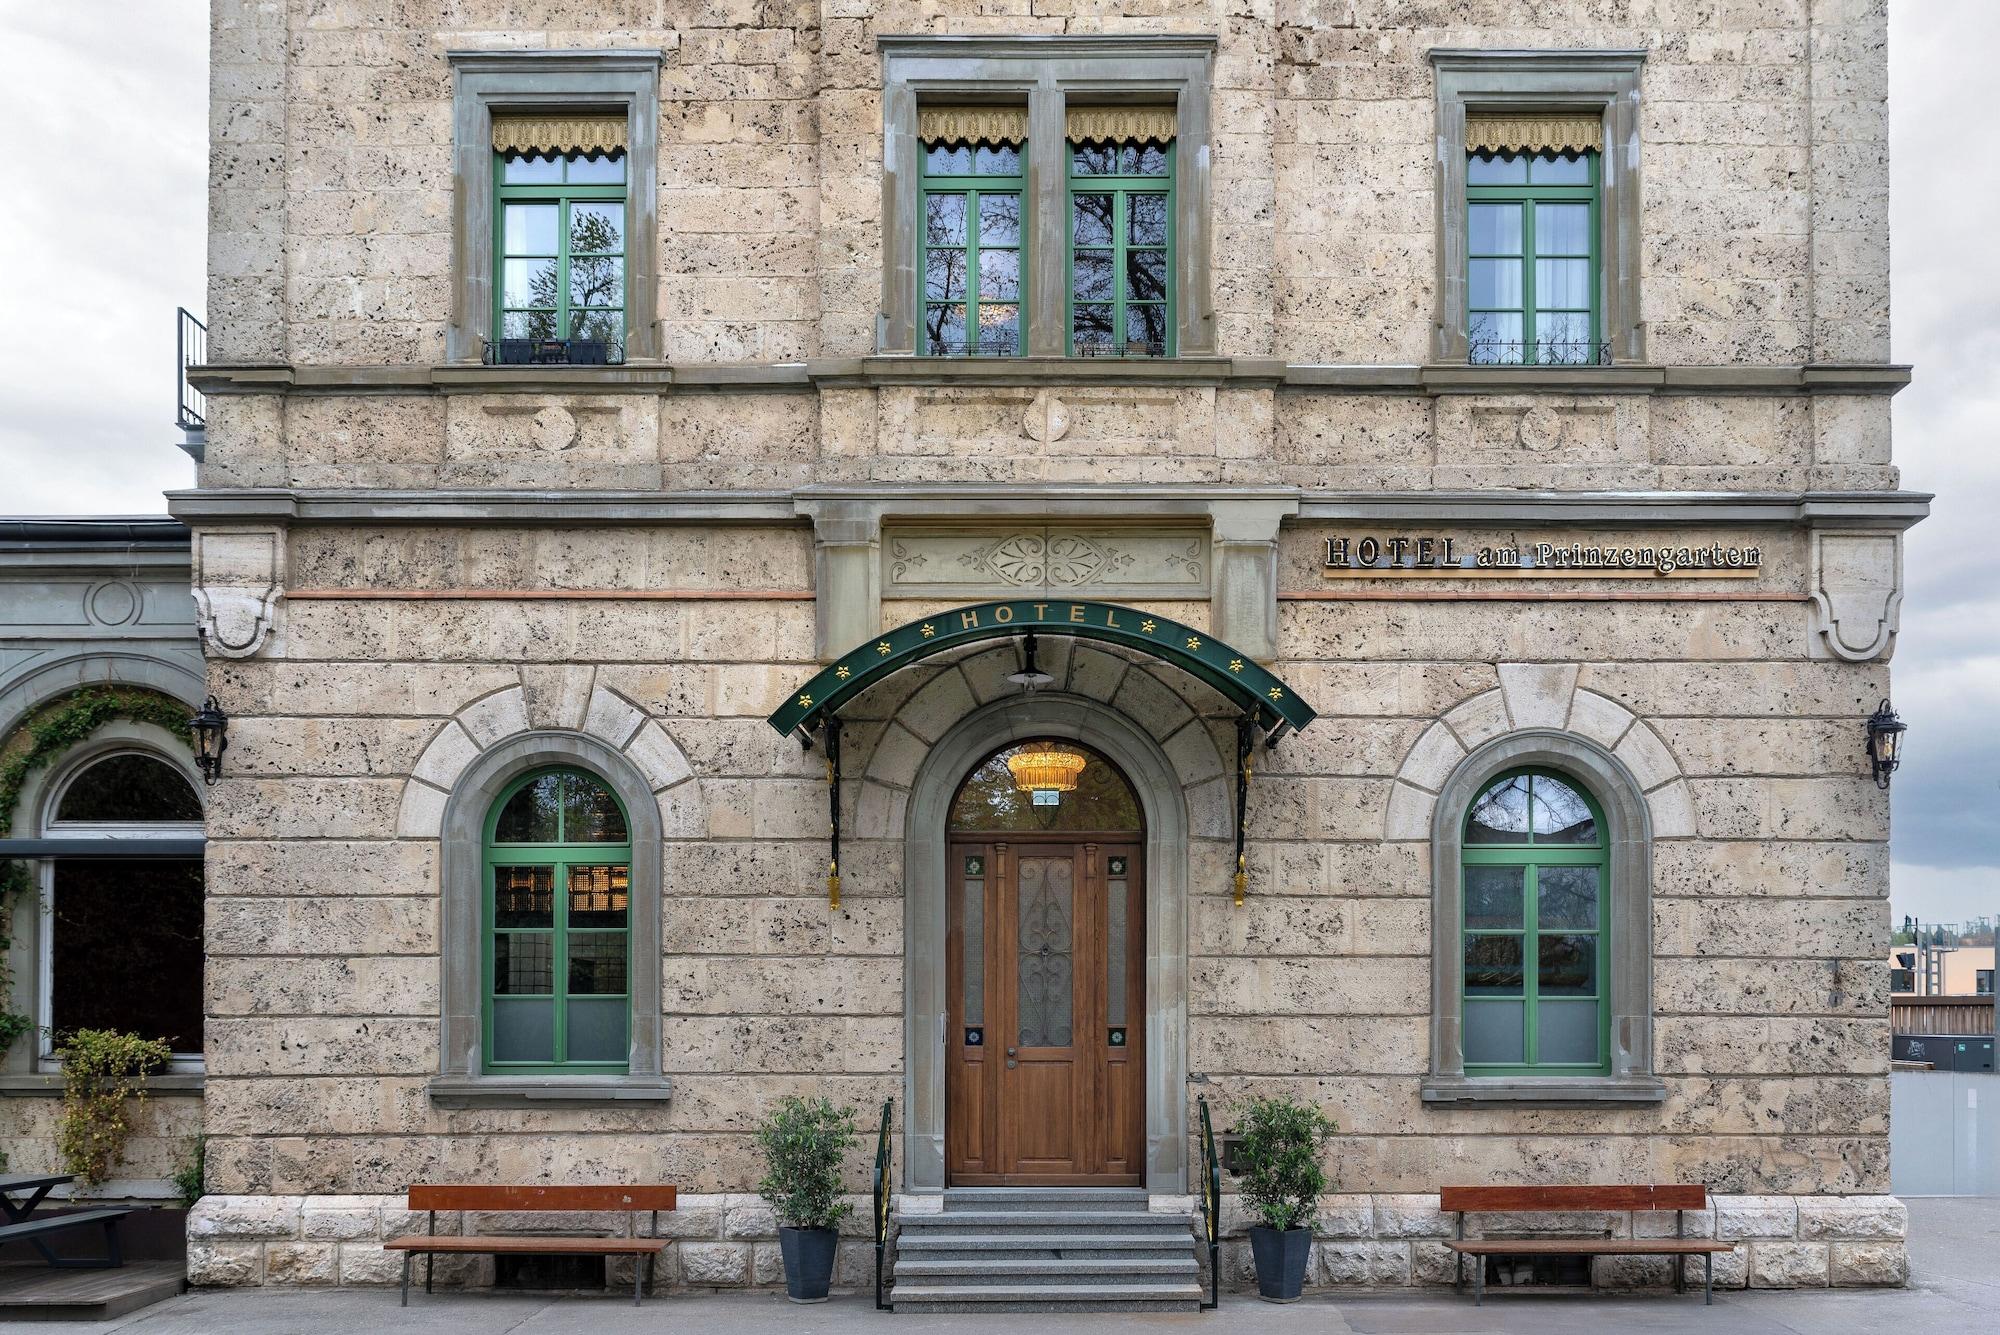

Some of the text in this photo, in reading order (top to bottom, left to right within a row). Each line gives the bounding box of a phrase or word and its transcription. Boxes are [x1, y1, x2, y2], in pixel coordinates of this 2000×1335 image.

[1325, 537, 1762, 573] HOTEL am Prinzengarten
[961, 604, 1121, 629] HOTEL
